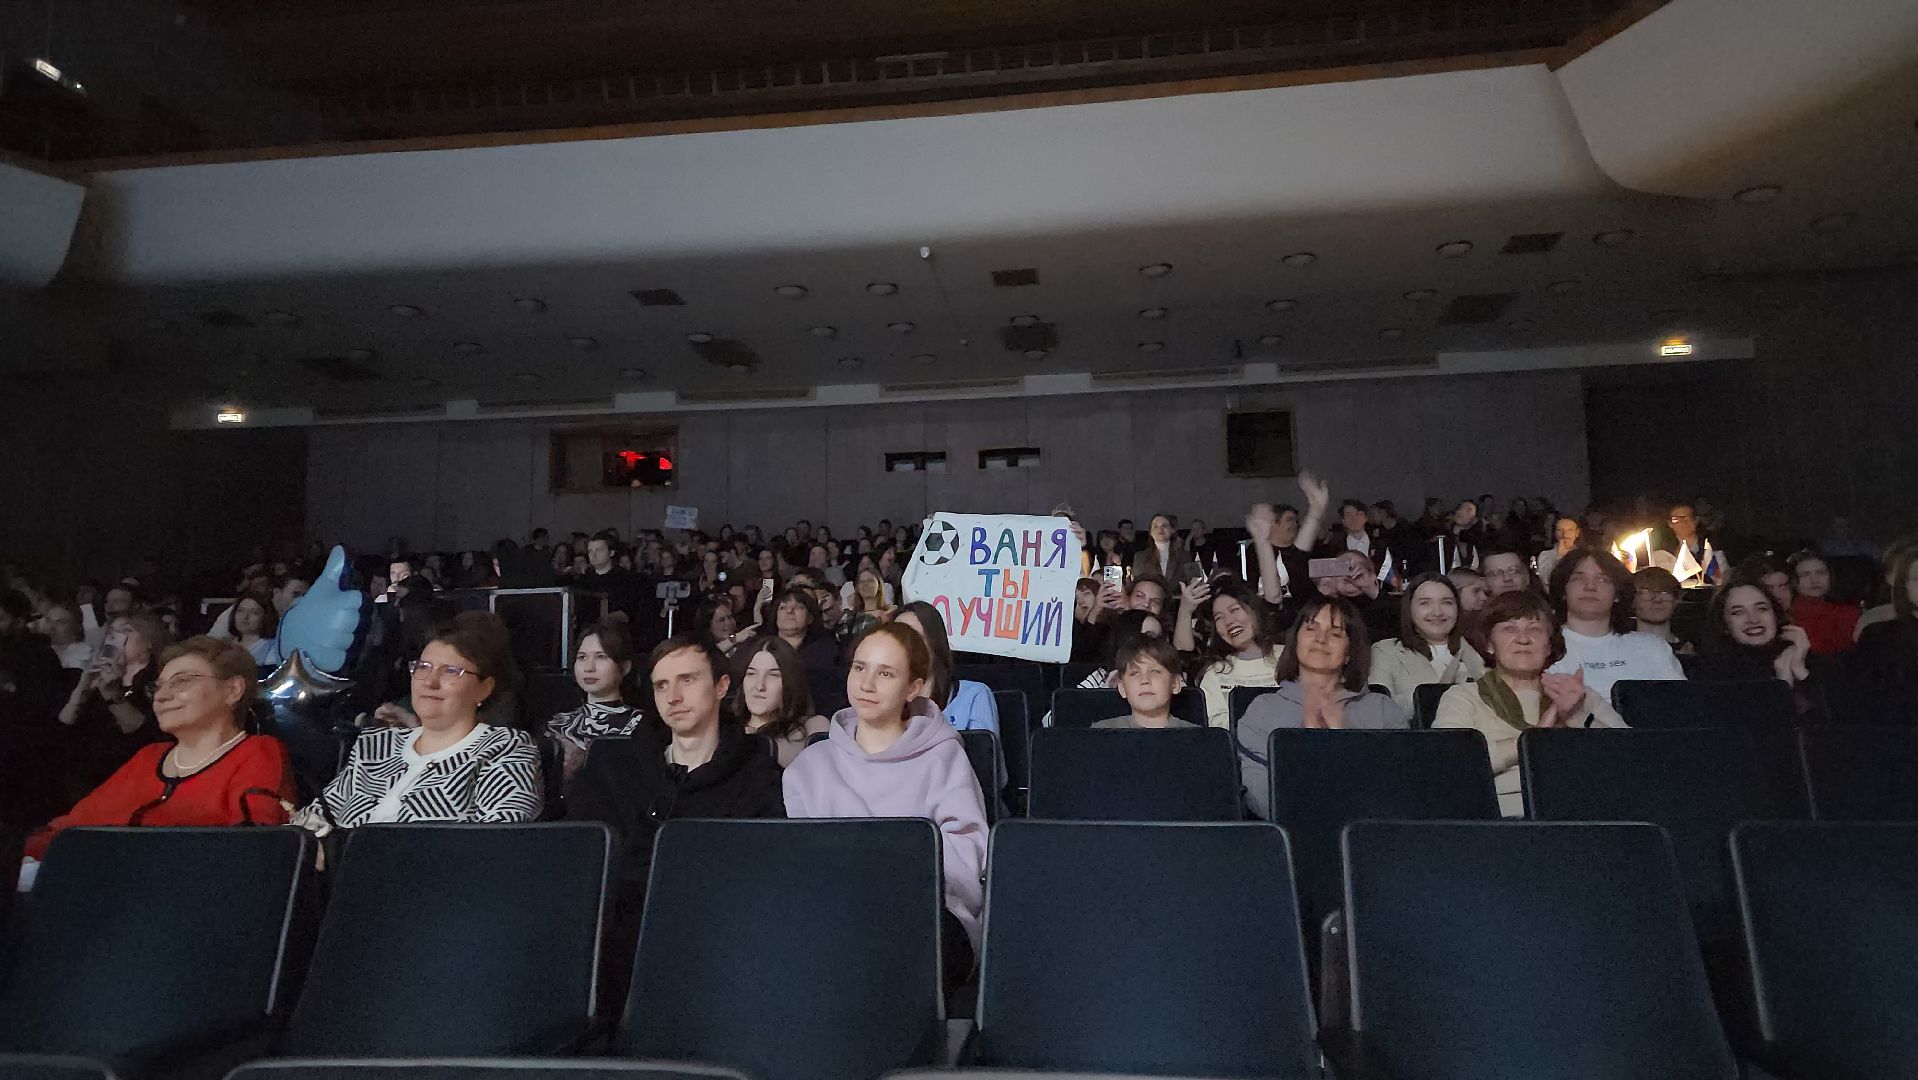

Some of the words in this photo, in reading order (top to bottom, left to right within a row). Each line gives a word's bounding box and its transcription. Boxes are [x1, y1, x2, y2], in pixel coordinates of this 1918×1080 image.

[969, 526, 1068, 569] ВАНЯ
[977, 567, 1030, 599] ТЫ
[1583, 659, 1606, 670] hate
[1609, 659, 1626, 668] sex
